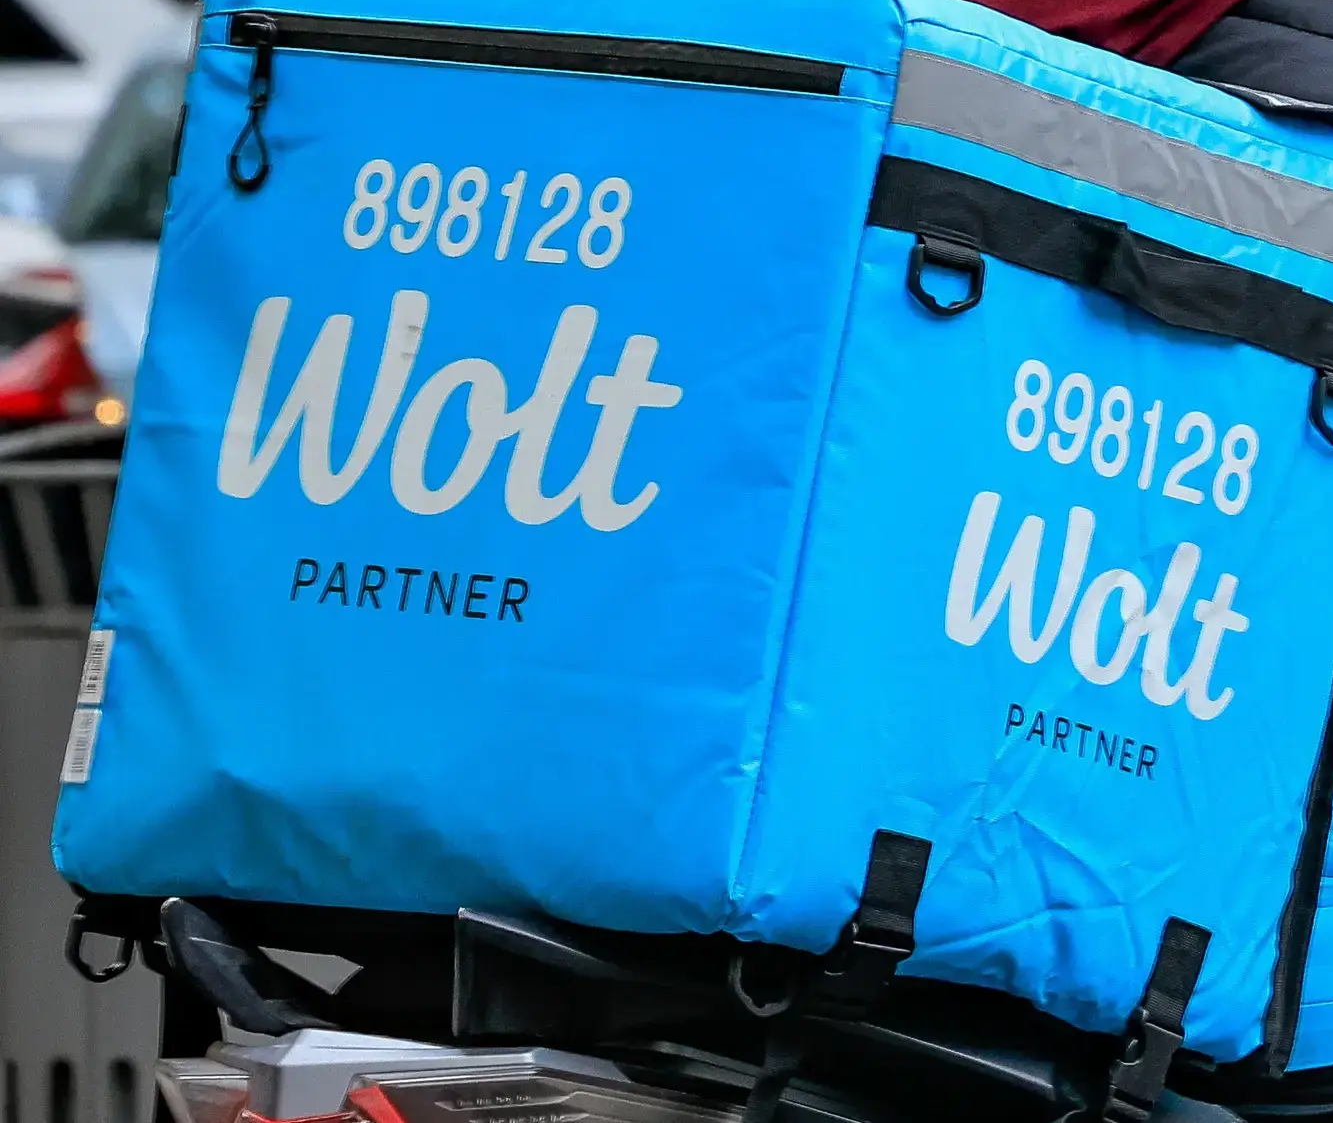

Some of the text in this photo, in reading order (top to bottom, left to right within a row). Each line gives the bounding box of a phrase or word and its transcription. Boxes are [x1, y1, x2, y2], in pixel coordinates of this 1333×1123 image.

[345, 160, 632, 269] 898128
[217, 290, 683, 532] Wolt
[1006, 359, 1259, 516] 898128
[290, 558, 530, 623] PARTNER
[945, 491, 1249, 720] Wolt
[1004, 703, 1159, 780] PARTNER
